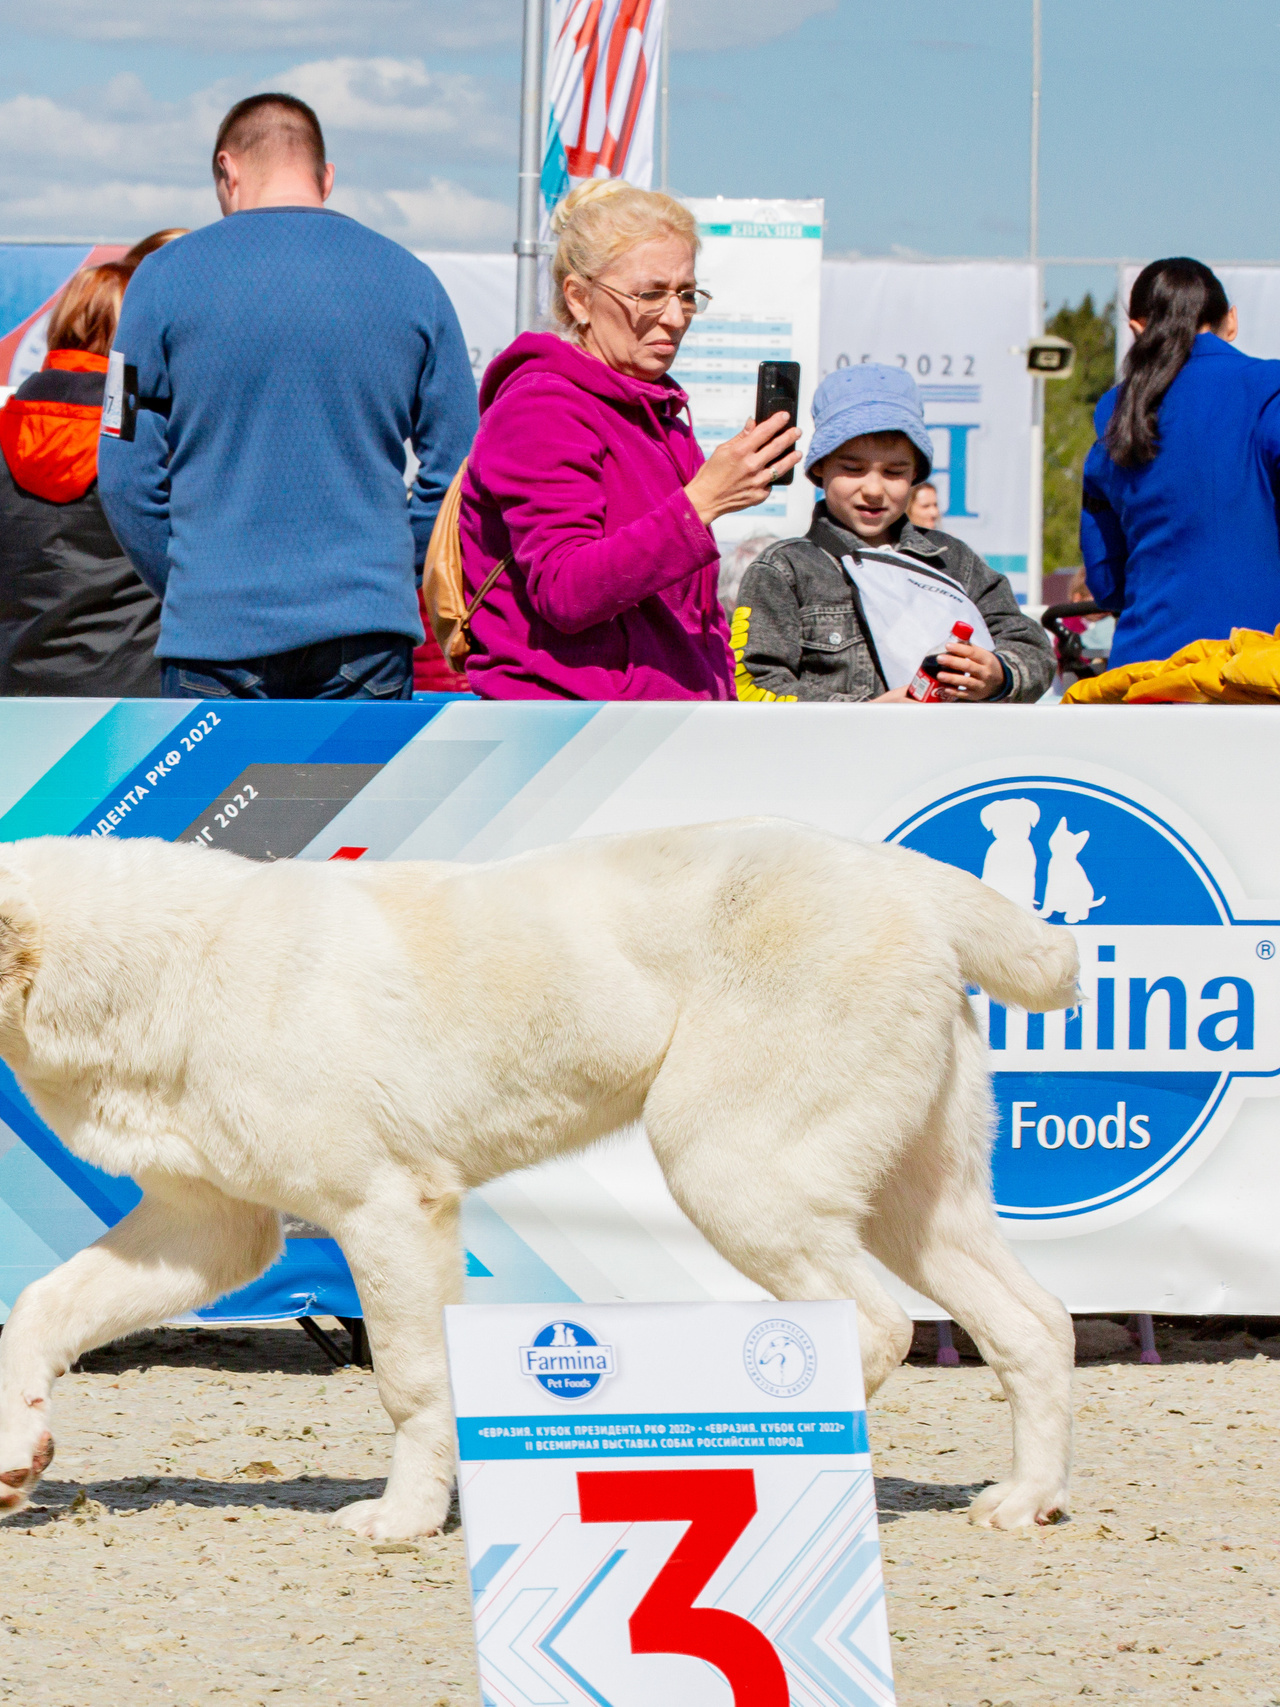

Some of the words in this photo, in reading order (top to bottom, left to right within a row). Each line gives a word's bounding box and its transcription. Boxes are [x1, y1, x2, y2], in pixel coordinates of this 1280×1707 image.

[731, 223, 804, 238] ЕВРАЗИЯ
[145, 750, 182, 786] РКФ
[179, 711, 222, 752] 2022
[214, 784, 259, 828] 2022
[1011, 1100, 1151, 1150] Foods
[527, 1350, 607, 1370] Farmina
[547, 1378, 562, 1388] Pet
[564, 1378, 591, 1388] Foods
[478, 1426, 534, 1437] «ЕВРАЗИЯ.
[536, 1426, 571, 1437] КУБОК
[574, 1425, 642, 1436] ПРЕЗИДЕНТА
[644, 1424, 666, 1434] РКФ
[761, 1423, 795, 1433] КУБОК
[797, 1422, 816, 1432] СНГ
[536, 1440, 599, 1451] ВСЕМИРНАЯ
[602, 1438, 658, 1449] ВЫСТАВКА
[660, 1437, 694, 1448] СОБАК
[697, 1436, 765, 1448] РОССИЙСКИХ
[768, 1436, 804, 1448] ПОРОД
[576, 1469, 790, 1707] 3
